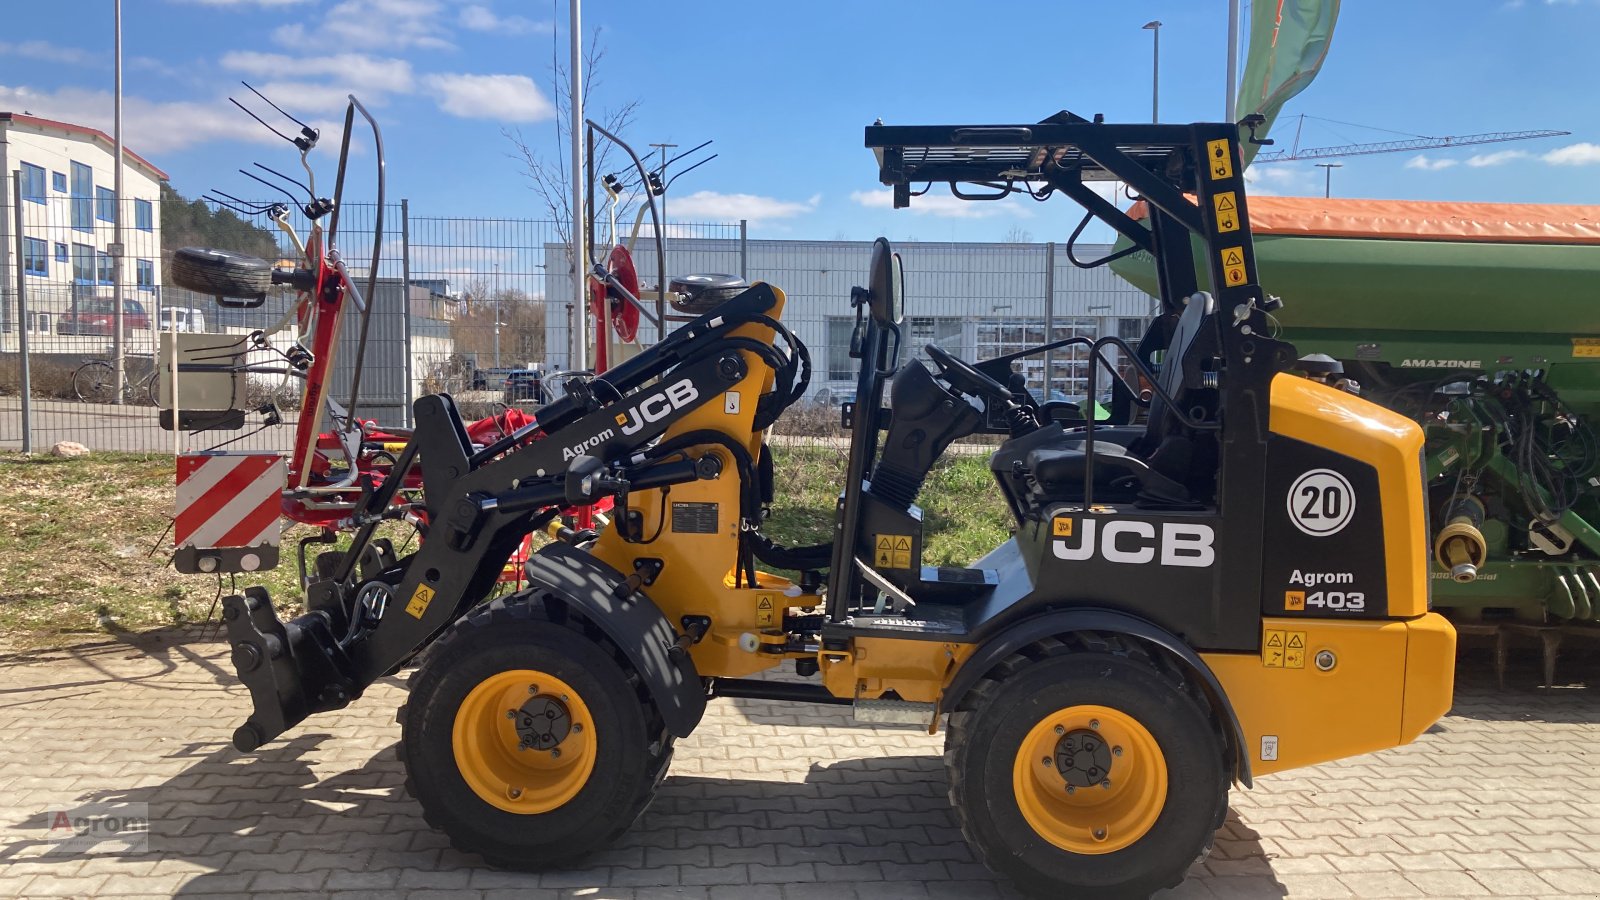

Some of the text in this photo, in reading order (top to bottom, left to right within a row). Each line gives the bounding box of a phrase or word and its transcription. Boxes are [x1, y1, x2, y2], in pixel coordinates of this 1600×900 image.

[1401, 359, 1481, 368] AMAZONE
[620, 378, 699, 436] JCB
[562, 428, 615, 461] Agrom
[1301, 486, 1341, 519] 20
[1052, 518, 1215, 568] JCB
[1289, 569, 1354, 587] Agrom
[1306, 591, 1365, 609] 403
